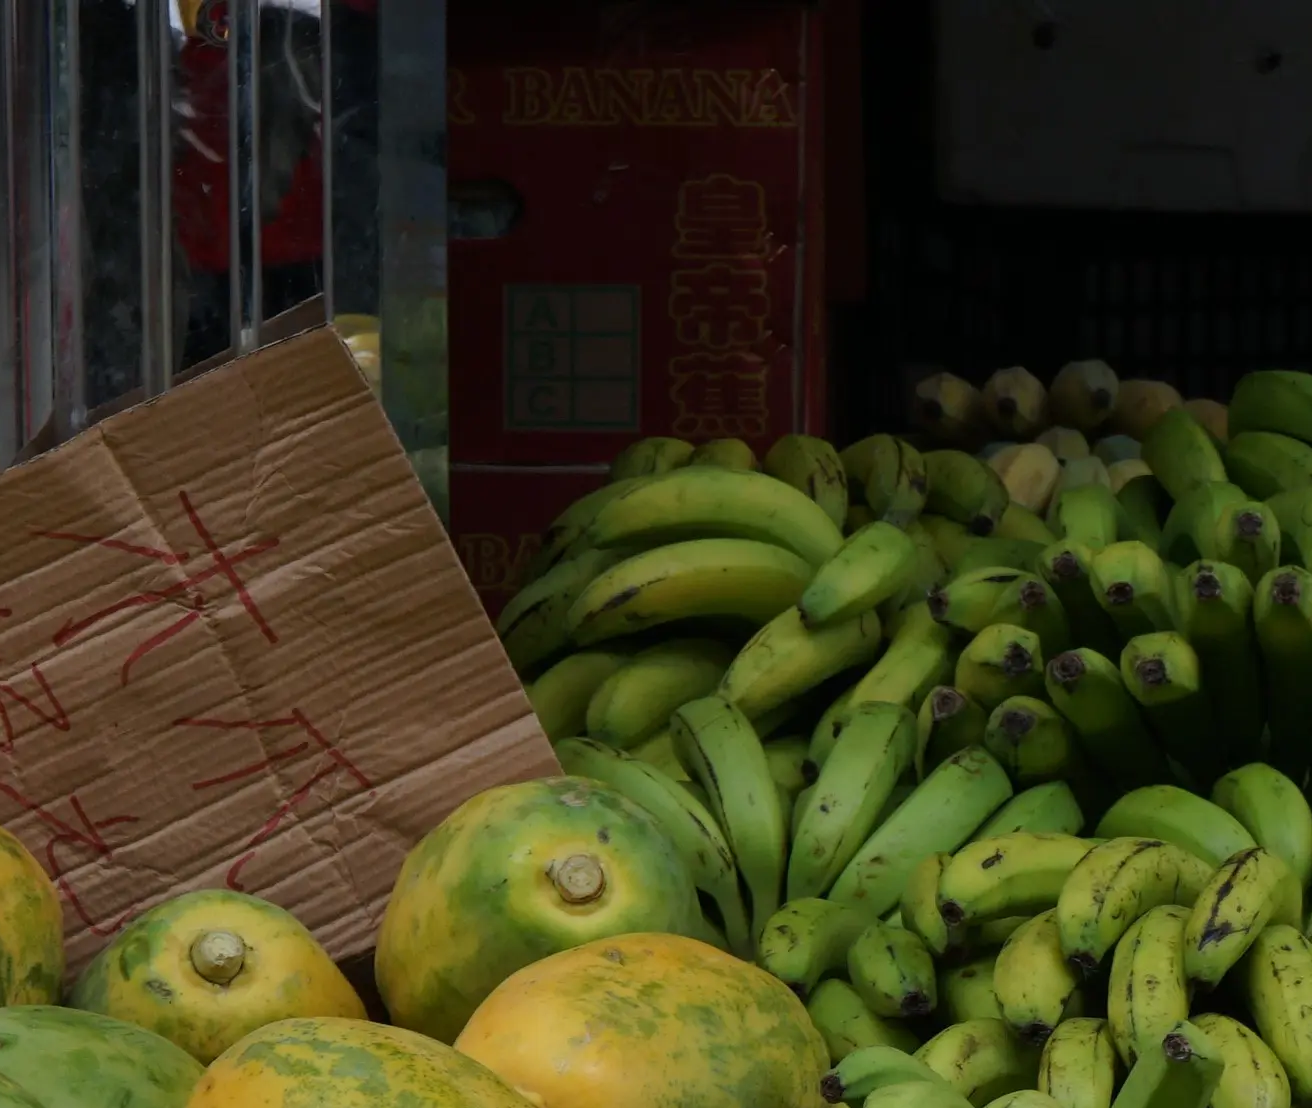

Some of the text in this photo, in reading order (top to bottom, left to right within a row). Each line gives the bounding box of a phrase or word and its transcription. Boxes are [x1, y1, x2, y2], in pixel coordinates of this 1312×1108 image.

[503, 67, 798, 127] BANANA
[525, 296, 557, 327] A
[670, 173, 770, 437] 皇帝蕉
[529, 341, 555, 371] B
[528, 386, 556, 416] C
[31, 490, 374, 892] 木瓜
